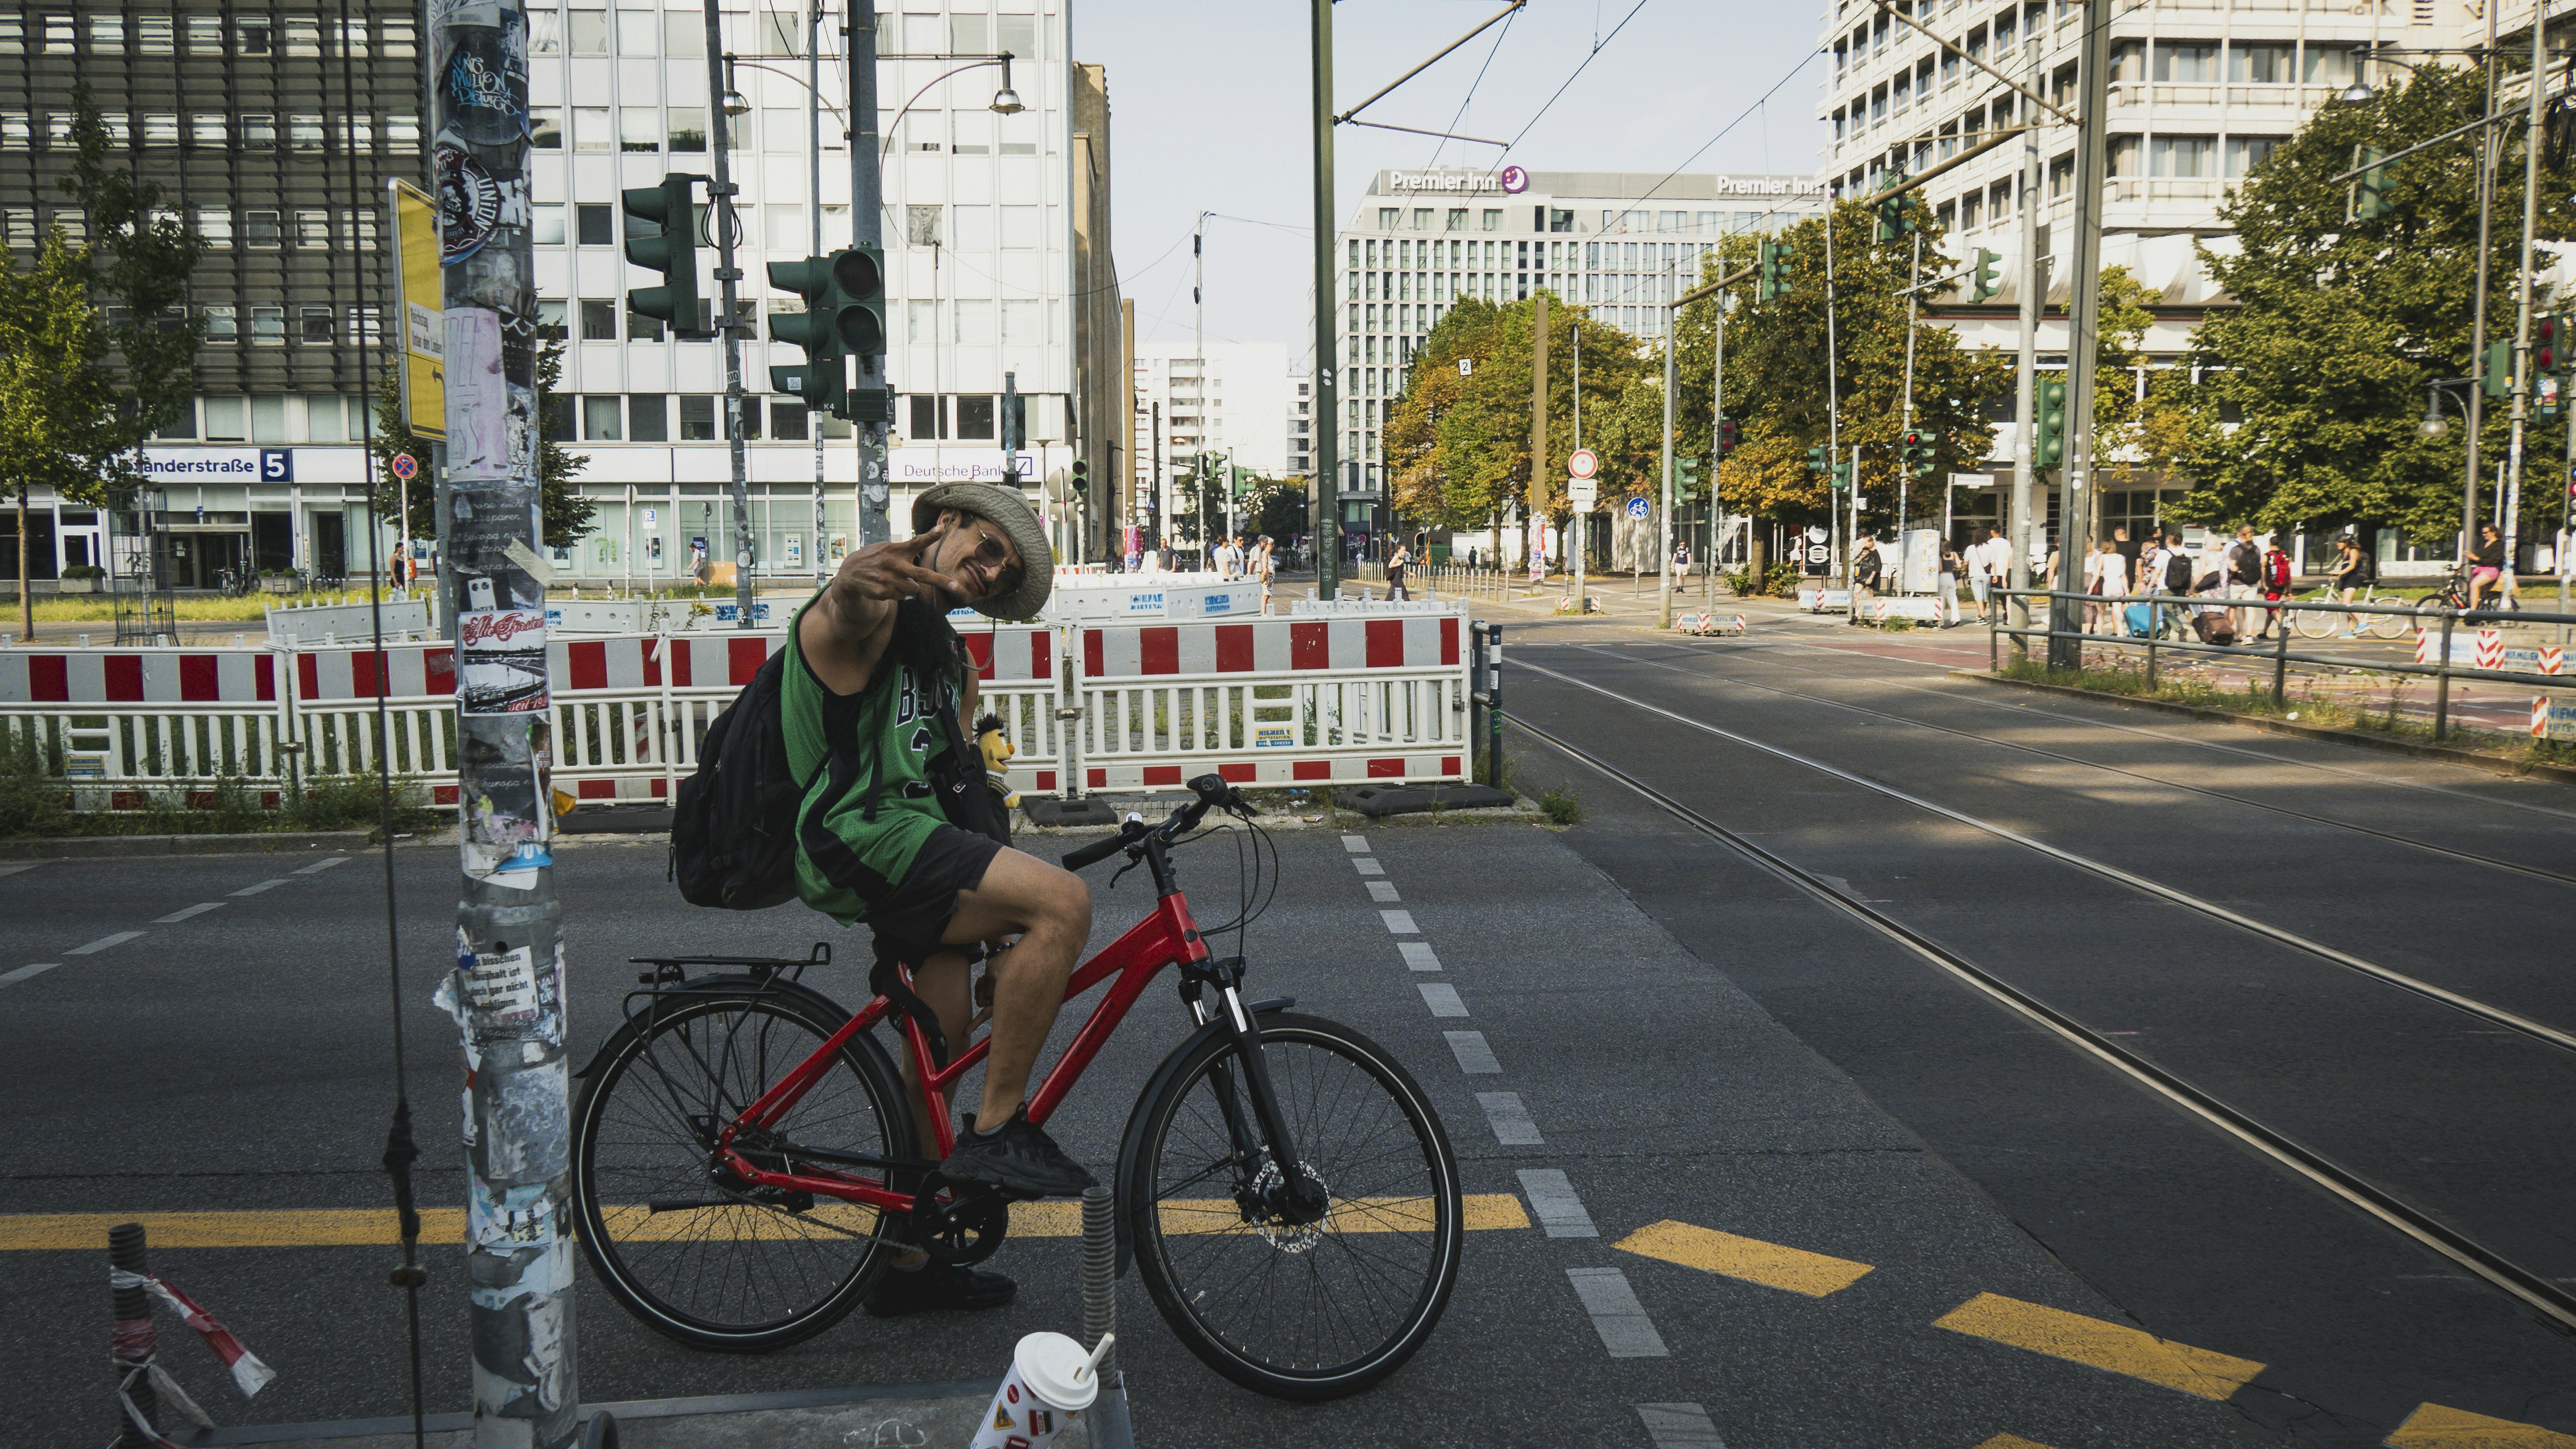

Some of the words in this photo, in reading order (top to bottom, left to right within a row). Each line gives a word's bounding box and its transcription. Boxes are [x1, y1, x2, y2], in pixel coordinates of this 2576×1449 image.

[1391, 171, 1465, 189] Premier
[1469, 172, 1496, 190] Inn
[1718, 176, 1790, 194] Premier
[410, 308, 429, 332] Reichstag
[412, 330, 422, 348] Unter
[430, 337, 443, 355] Linden
[1463, 362, 1468, 371] 2
[267, 454, 285, 477] 5
[905, 464, 968, 476] Deutsche
[972, 464, 1005, 476] Bank
[482, 953, 521, 966] bisschen
[509, 967, 521, 977] ist
[489, 986, 504, 997] gar
[505, 980, 529, 993] nicht
